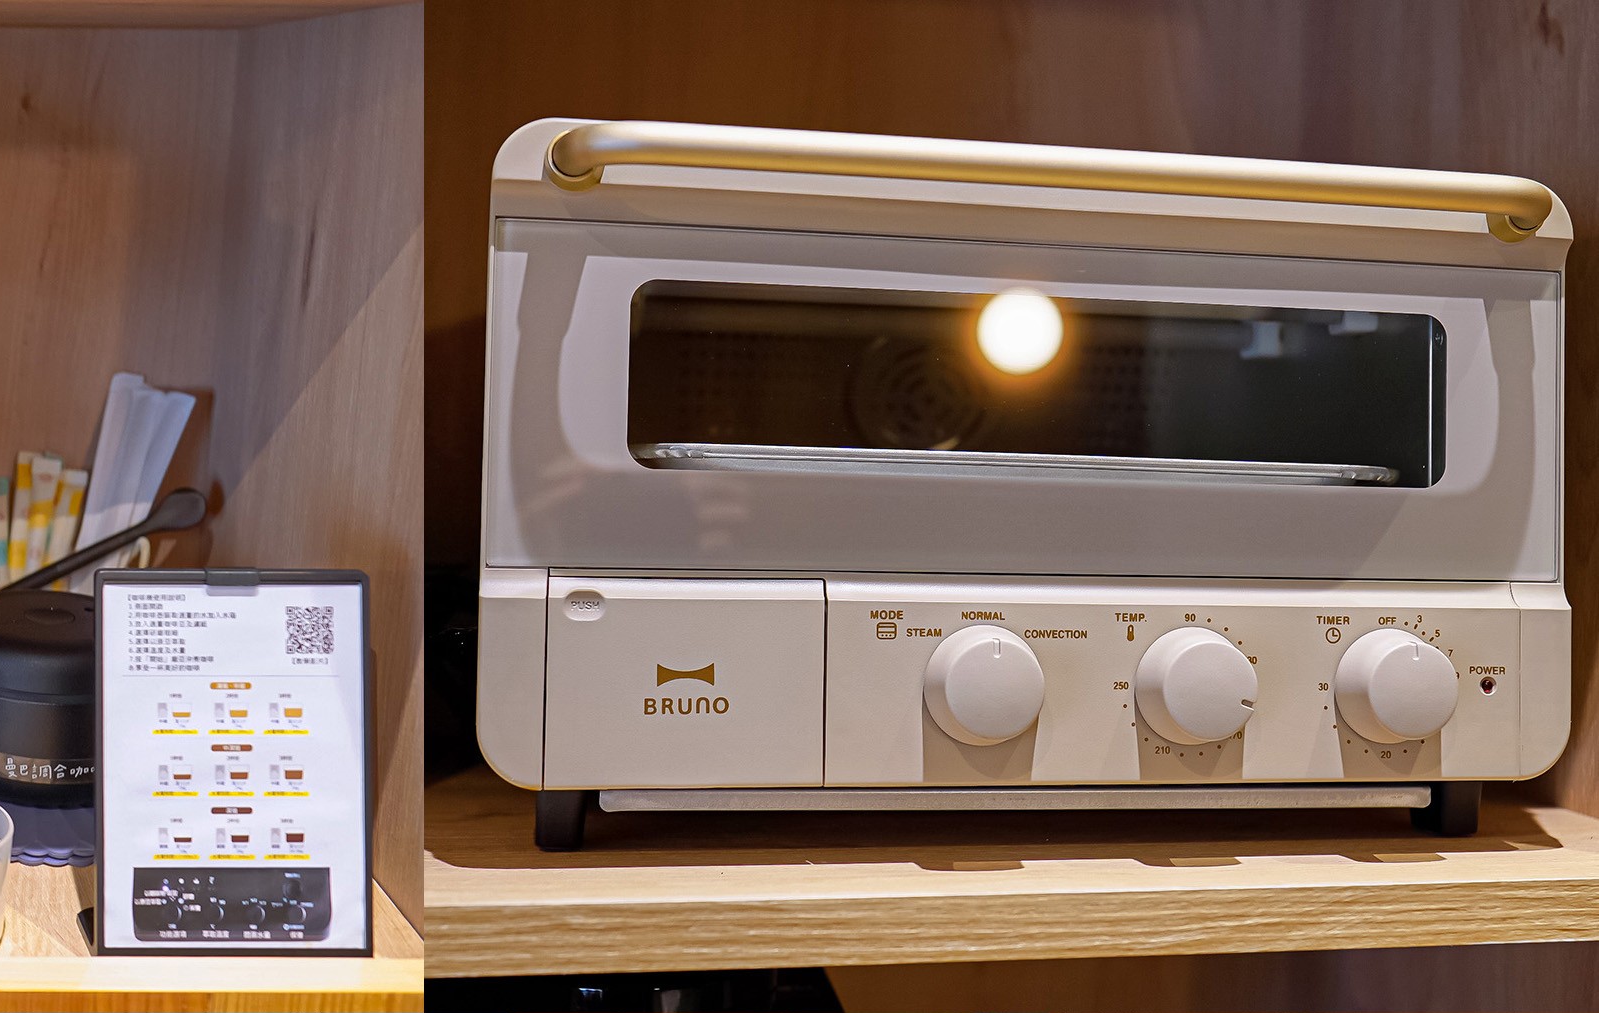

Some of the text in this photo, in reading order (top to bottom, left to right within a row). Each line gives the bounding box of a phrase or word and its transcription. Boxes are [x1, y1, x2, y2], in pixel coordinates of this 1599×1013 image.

[571, 601, 600, 611] PUSH
[870, 610, 904, 620] MODE
[961, 611, 1006, 621] NORMAL
[1114, 612, 1148, 622] TEMP.
[1184, 613, 1196, 622] 90
[1417, 614, 1423, 623] 3
[1316, 615, 1350, 625] TIMER
[1378, 616, 1397, 625] OFF
[906, 628, 942, 638] STEAM
[1024, 629, 1088, 639] CONVECTION
[1434, 629, 1441, 638] 5
[1448, 649, 1454, 657] 7
[1247, 656, 1258, 665] 30
[1469, 666, 1506, 675] POWER
[1113, 681, 1129, 690] 250
[1318, 682, 1329, 691] 30
[643, 696, 730, 716] BRUNO
[1154, 746, 1171, 755] 210
[1380, 750, 1392, 759] 20
[5, 757, 95, 779] 曼巴調合咖
